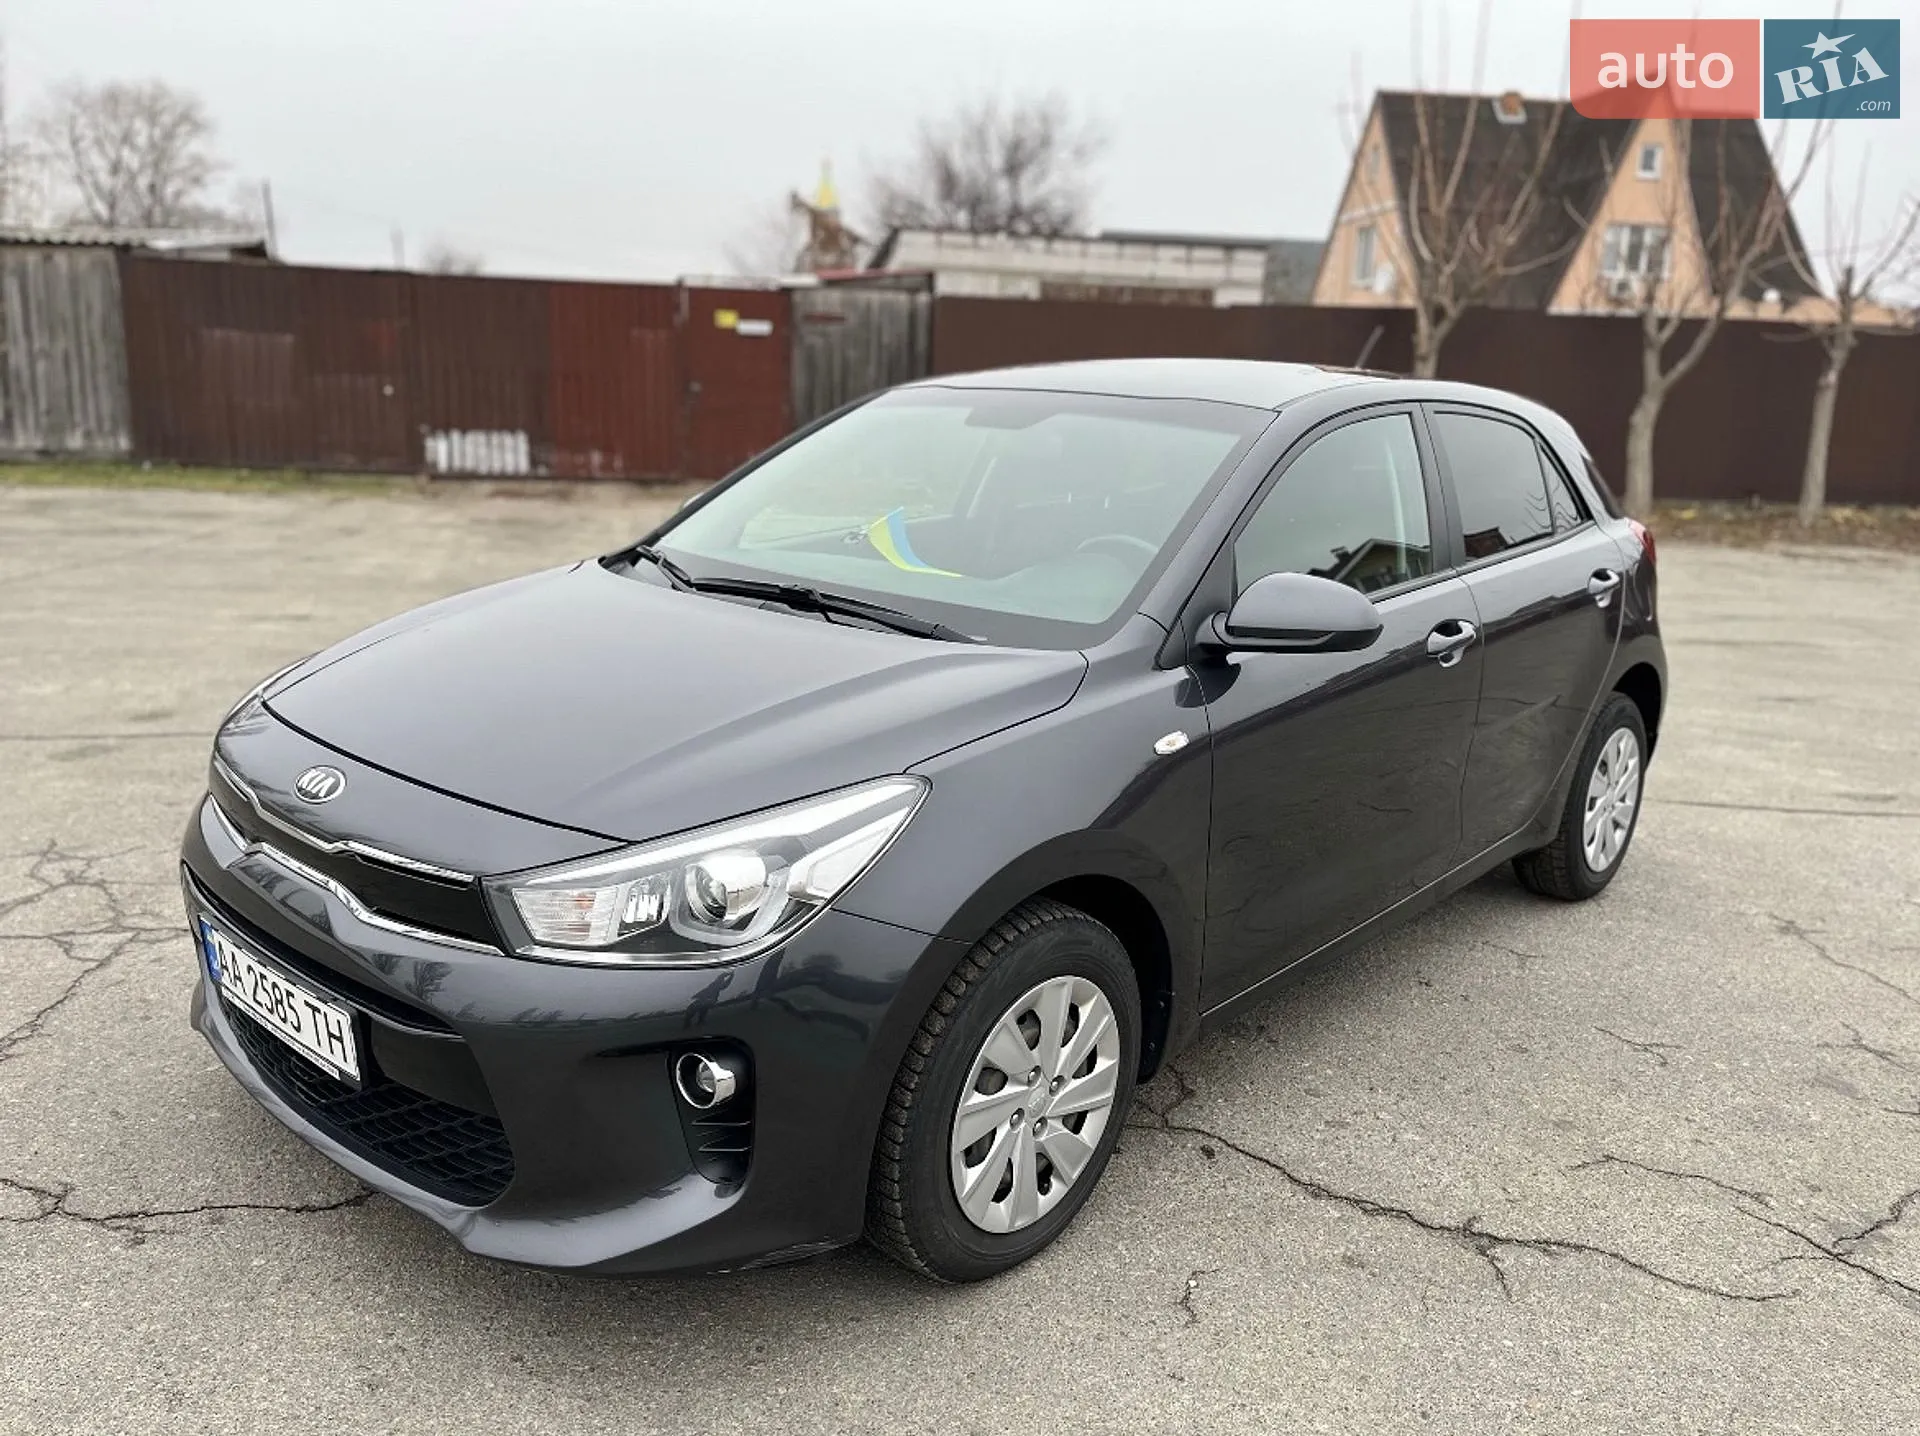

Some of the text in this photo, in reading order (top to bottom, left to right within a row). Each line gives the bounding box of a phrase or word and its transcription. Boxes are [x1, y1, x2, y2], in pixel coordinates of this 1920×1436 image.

[297, 768, 337, 799] KIA
[218, 940, 248, 996] AA
[248, 964, 301, 1034] 2585
[304, 999, 348, 1063] TH
